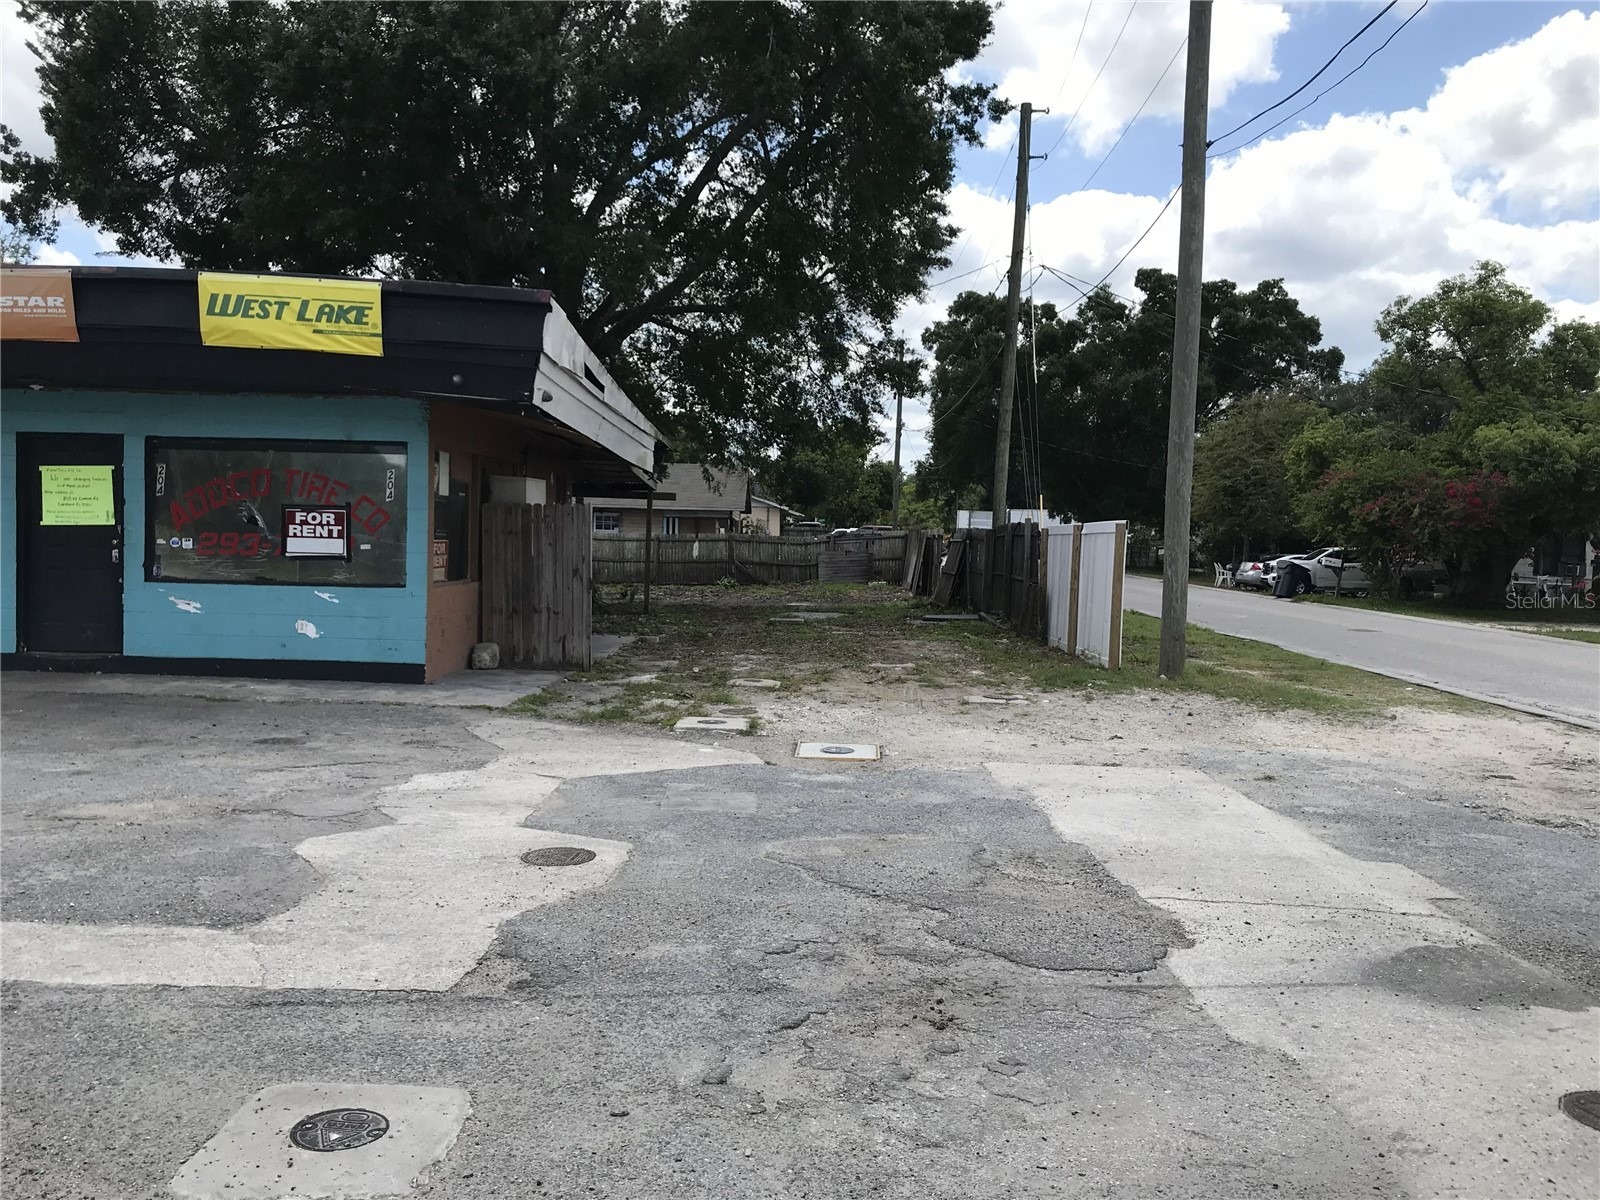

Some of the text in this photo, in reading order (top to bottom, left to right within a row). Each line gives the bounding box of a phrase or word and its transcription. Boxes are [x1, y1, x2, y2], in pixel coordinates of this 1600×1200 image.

[206, 293, 373, 325] WEST LAKE
[281, 467, 350, 506] TIRE
[295, 512, 335, 525] FOR
[288, 525, 342, 537] RENT
